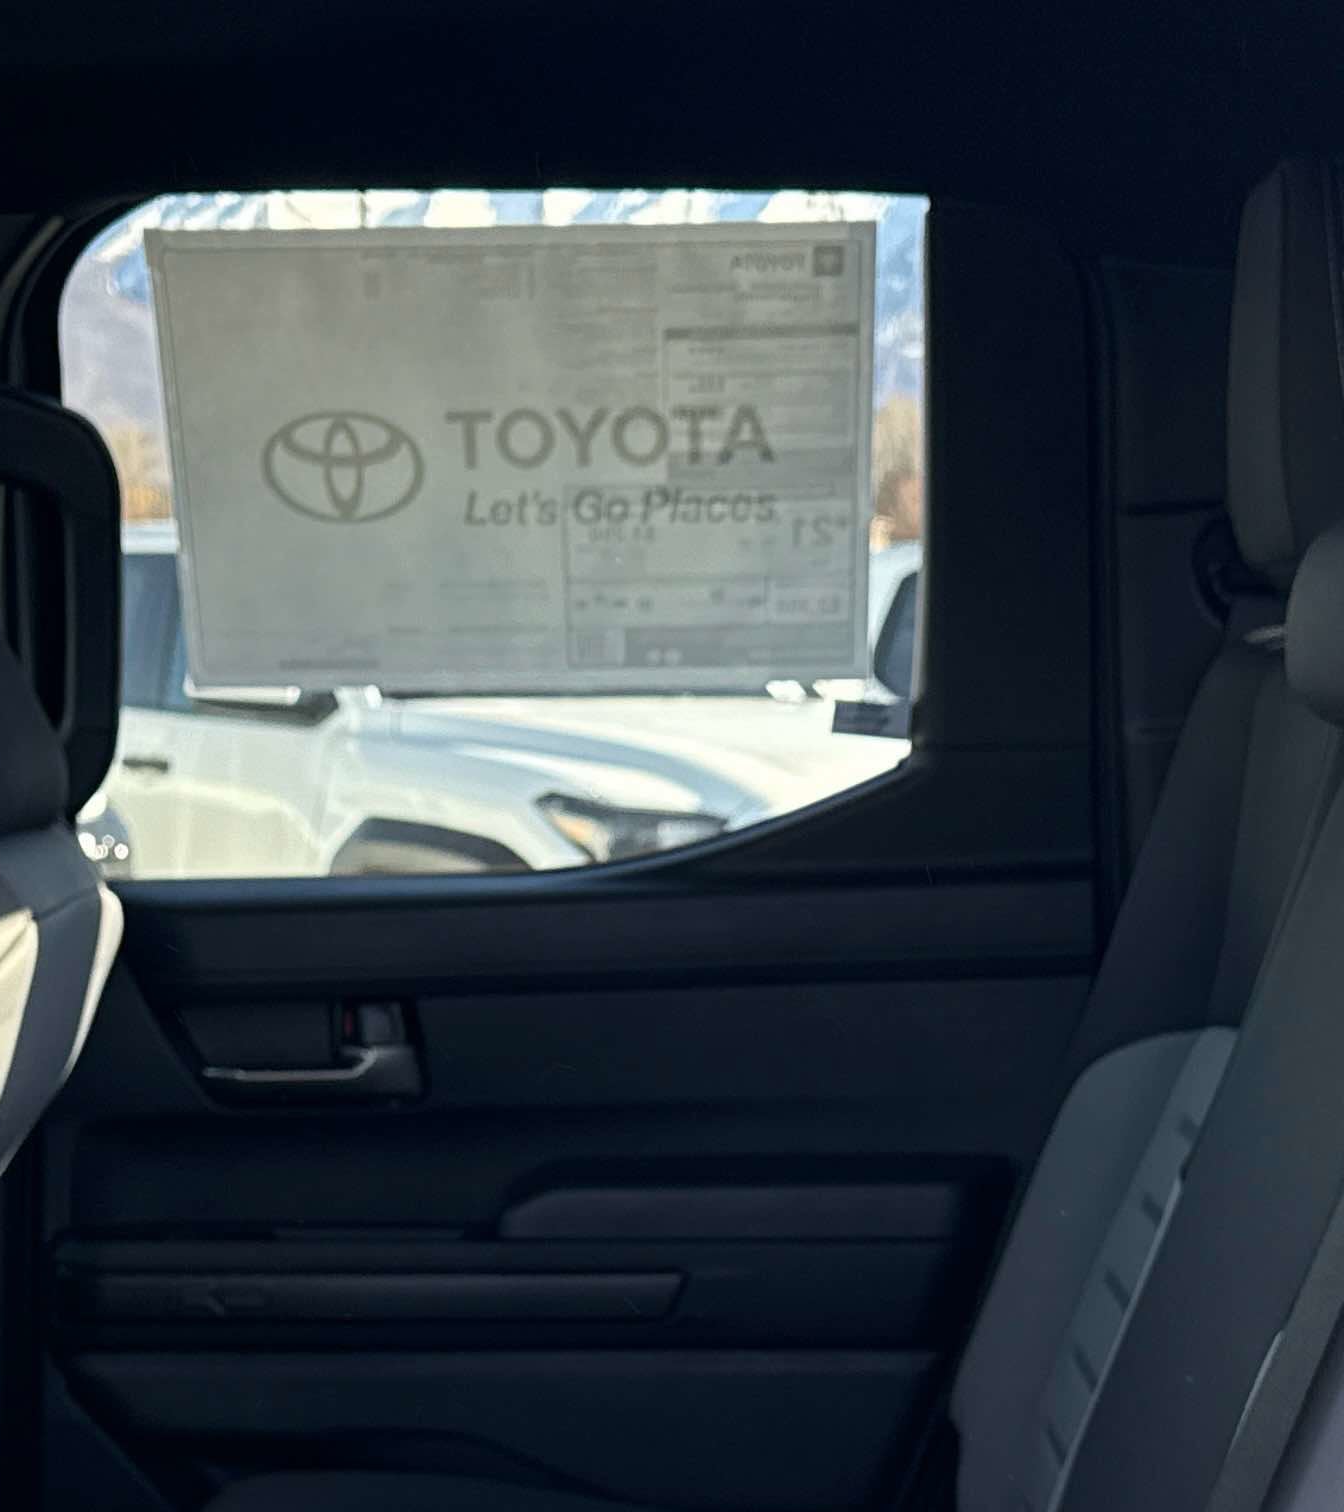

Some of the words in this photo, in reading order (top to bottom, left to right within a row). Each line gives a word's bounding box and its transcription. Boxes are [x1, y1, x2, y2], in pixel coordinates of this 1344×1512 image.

[444, 403, 775, 470] TOYOTA
[463, 489, 557, 527] Let's
[573, 488, 631, 525] Go
[639, 487, 777, 524] Places
